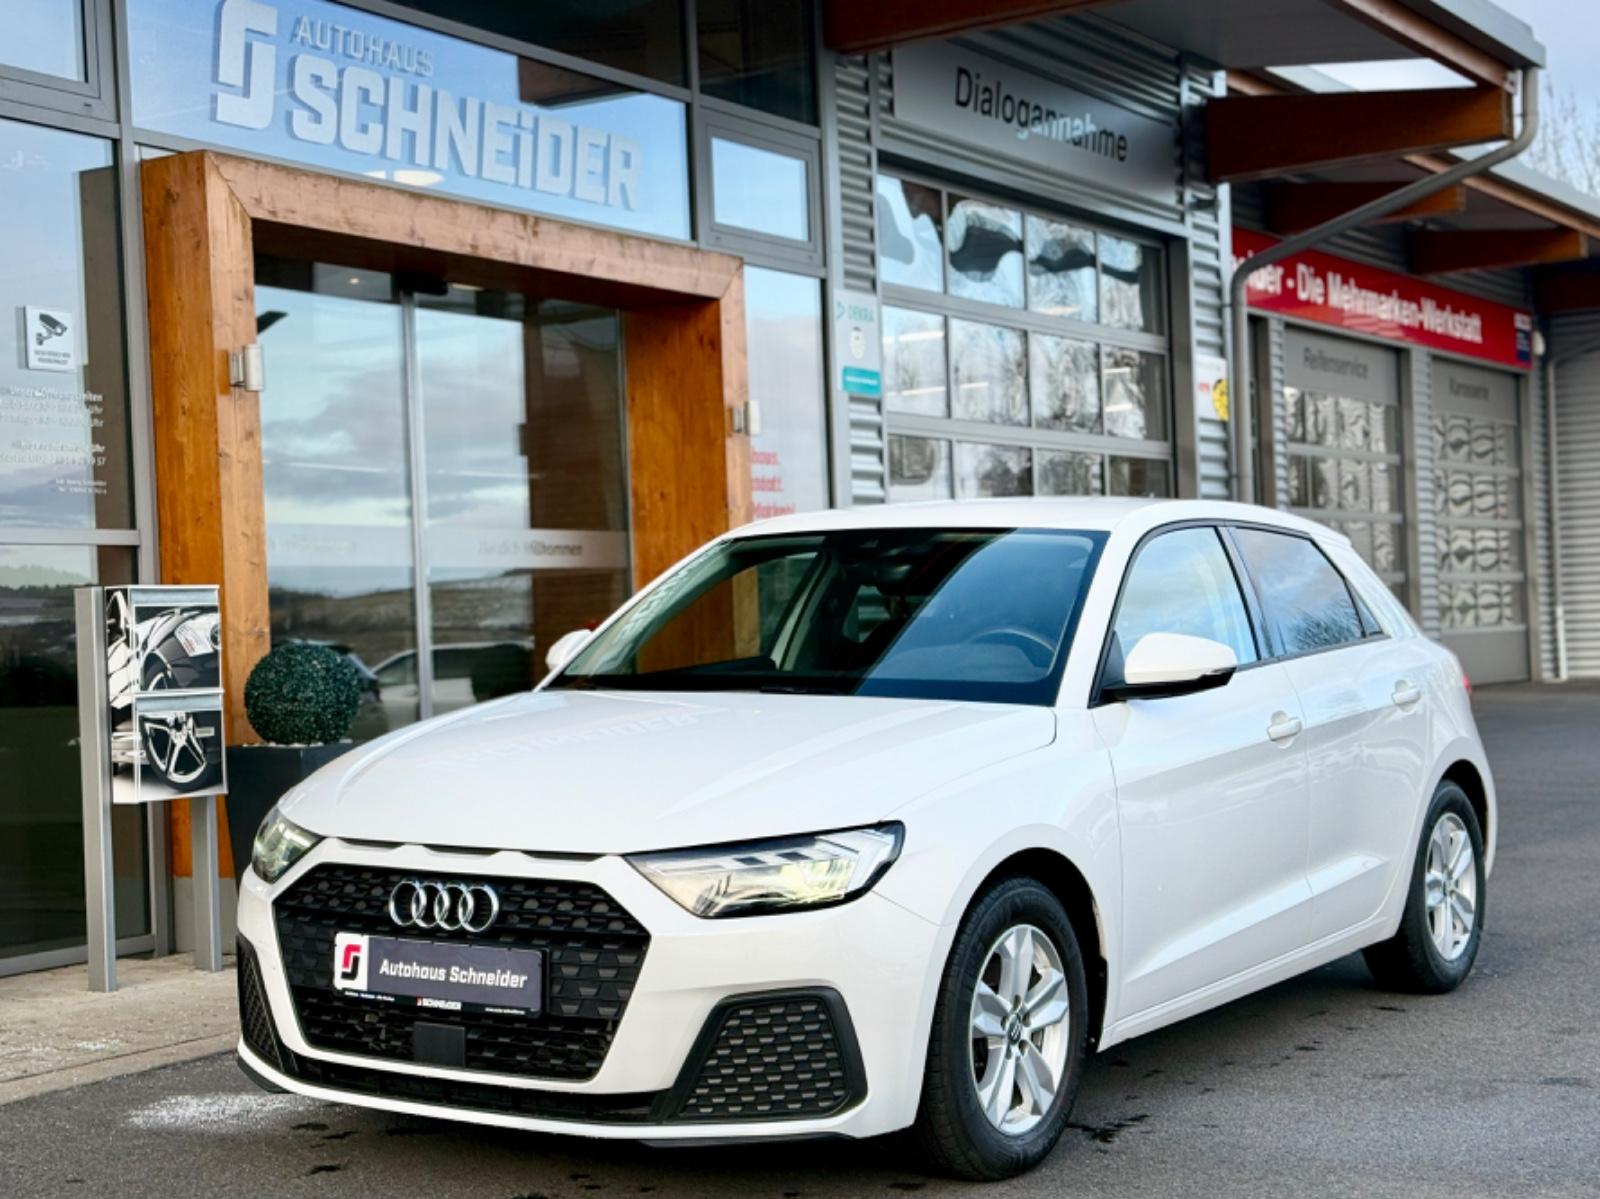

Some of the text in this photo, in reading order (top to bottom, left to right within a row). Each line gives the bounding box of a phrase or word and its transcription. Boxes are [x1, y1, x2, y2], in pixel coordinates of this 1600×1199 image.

[293, 15, 434, 77] AUTOHAUS
[955, 66, 1128, 163] Dialogannahme
[1297, 262, 1325, 305] Die
[1326, 270, 1483, 344] Mehrmarken-Werkstatt
[379, 958, 529, 989] Autohaus Schneider
